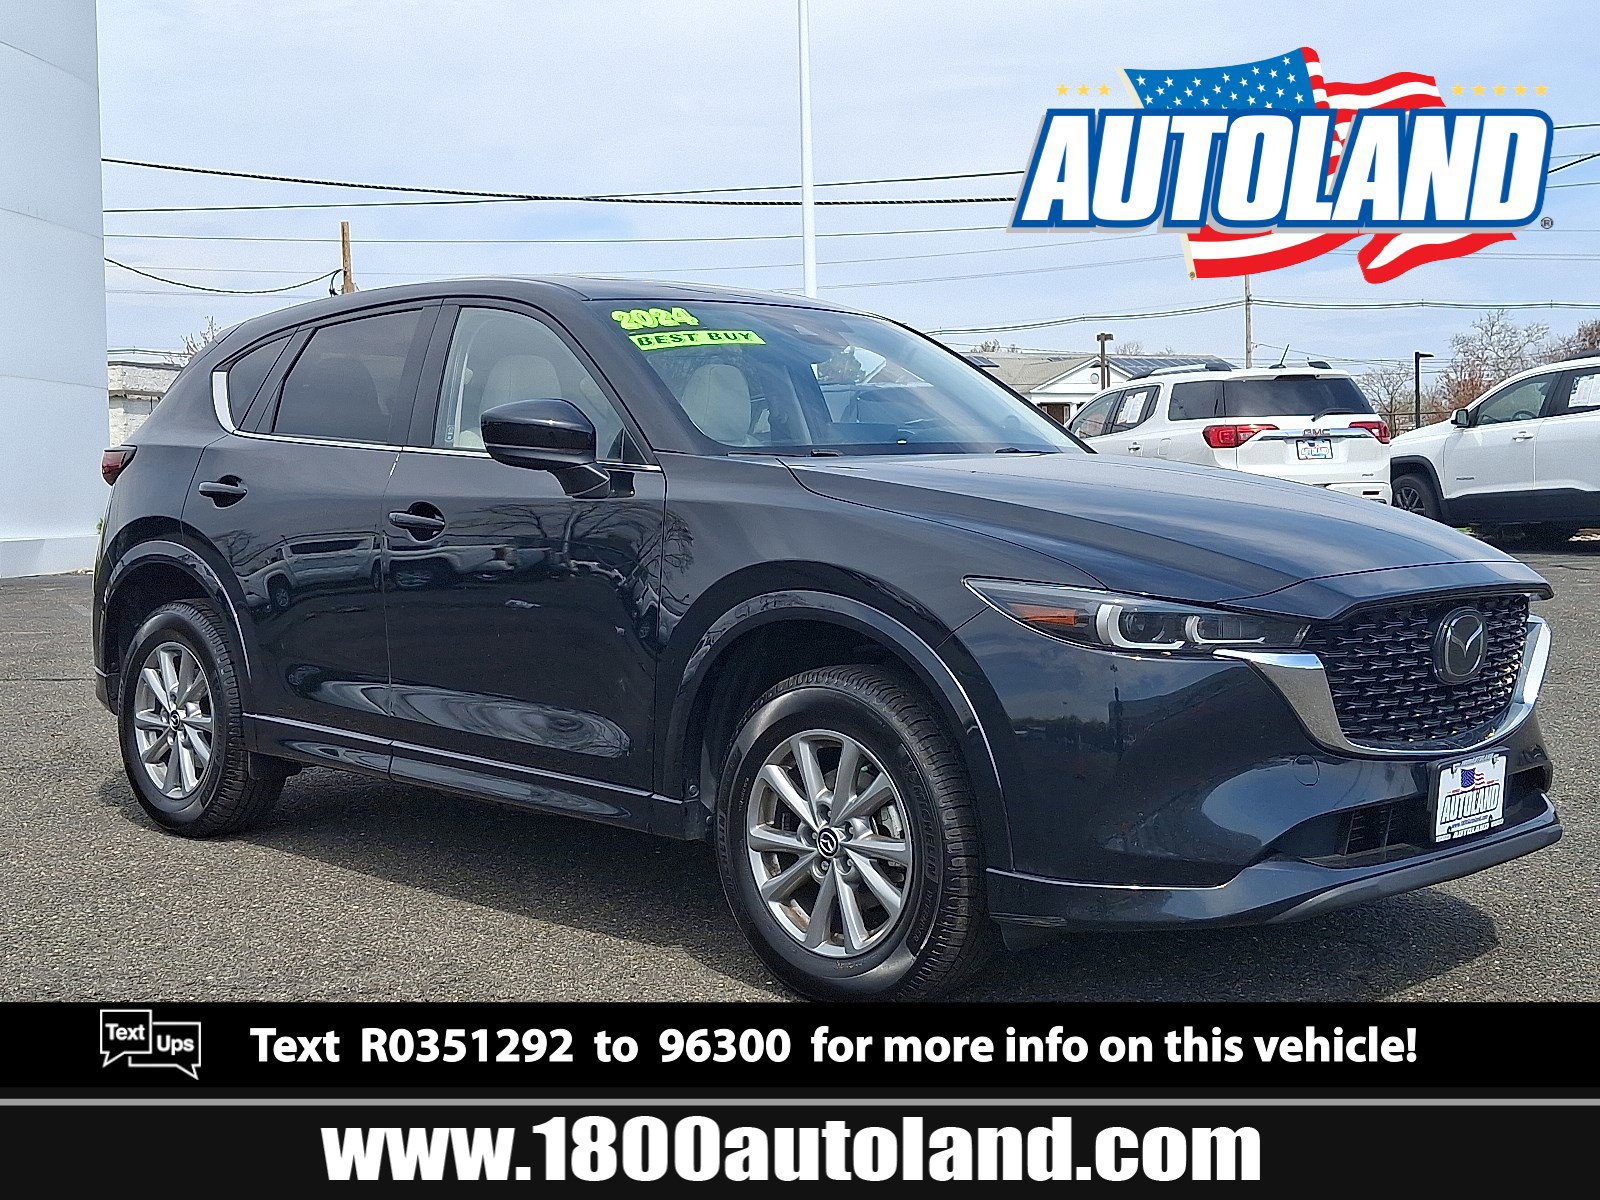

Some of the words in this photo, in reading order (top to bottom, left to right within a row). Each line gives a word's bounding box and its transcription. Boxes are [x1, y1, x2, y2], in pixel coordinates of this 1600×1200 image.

[611, 307, 699, 330] 2024
[637, 333, 697, 347] BEST
[707, 331, 752, 342] BUY
[1303, 428, 1331, 437] GMC
[1440, 784, 1500, 823] AUTOLAND
